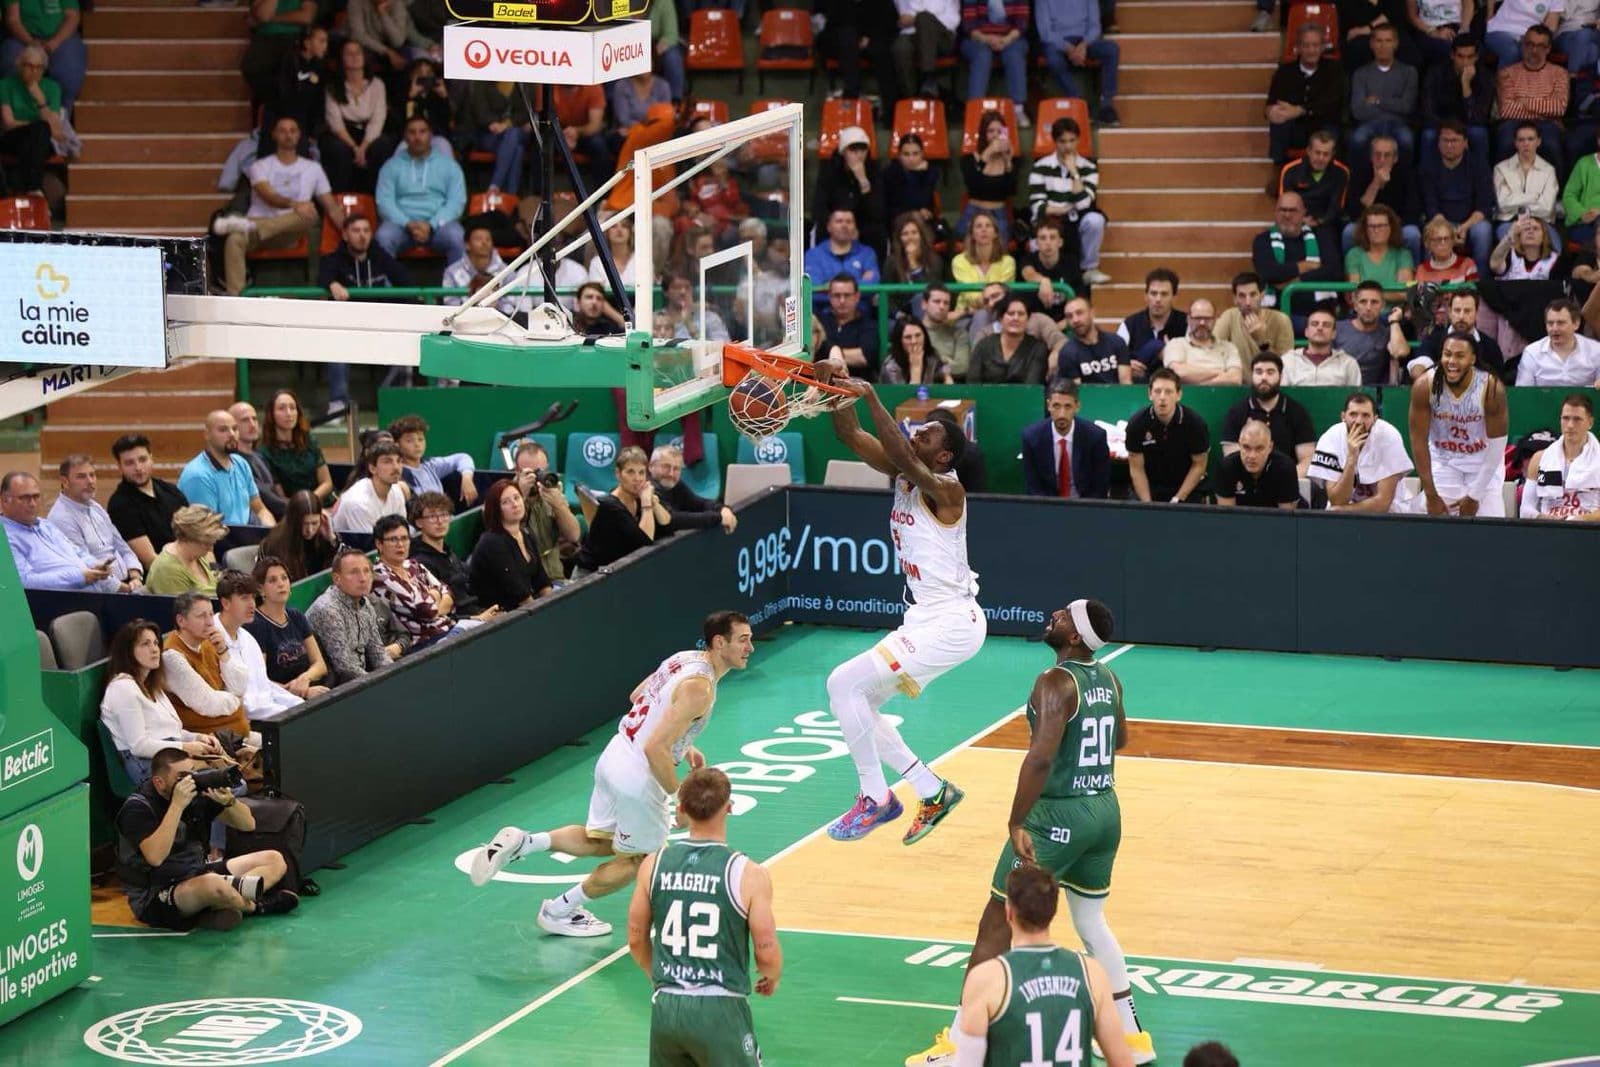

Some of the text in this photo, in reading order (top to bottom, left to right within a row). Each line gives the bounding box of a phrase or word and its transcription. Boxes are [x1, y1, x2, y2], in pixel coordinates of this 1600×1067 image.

[497, 5, 534, 18] Bodet
[495, 48, 573, 67] VEOLIA
[613, 43, 643, 63] VEOLIA
[20, 298, 90, 322] la mie
[22, 324, 91, 346] câline
[1080, 354, 1118, 375] BOSS
[1450, 426, 1469, 440] 23
[587, 441, 612, 458] CSP
[758, 443, 783, 459] CSP
[1562, 491, 1580, 508] 26
[889, 510, 915, 526] NACO
[737, 523, 904, 598] 9,99€/moi
[824, 595, 834, 610] à
[981, 607, 1045, 623] m/offres
[1078, 715, 1116, 767] 20
[4, 741, 49, 780] Betclic
[1050, 827, 1071, 844] 20
[660, 872, 721, 894] MAGRIT
[661, 900, 720, 959] 42
[0, 951, 77, 1005] lle sportive
[1020, 1009, 1083, 1067] 14
